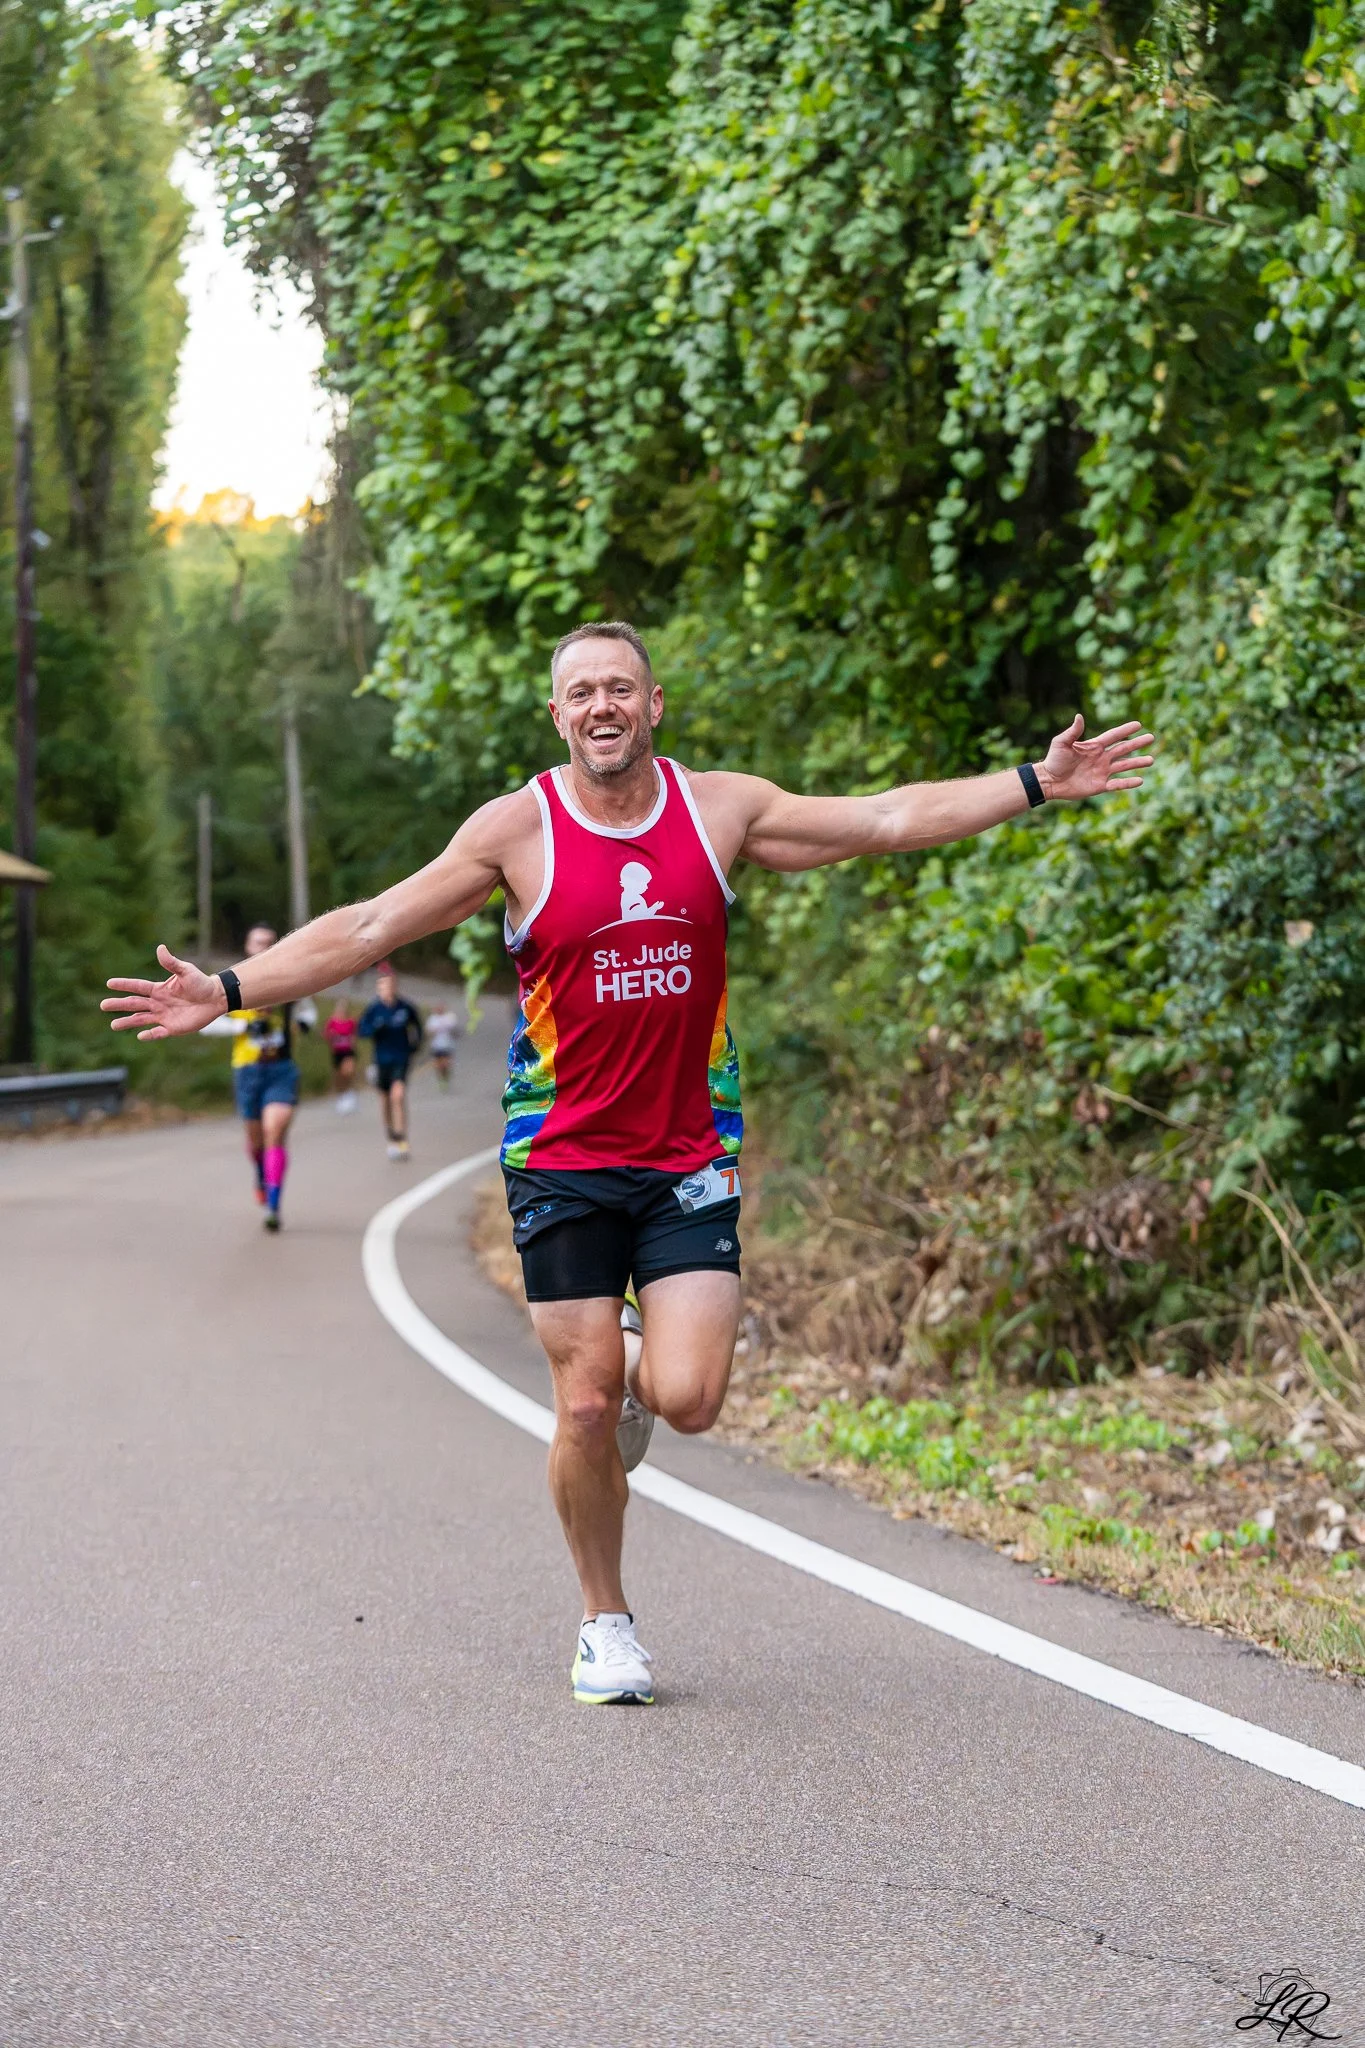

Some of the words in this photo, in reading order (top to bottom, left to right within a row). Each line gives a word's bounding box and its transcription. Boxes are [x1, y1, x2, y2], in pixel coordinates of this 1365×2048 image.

[593, 949, 628, 970] St.
[633, 940, 692, 966] Jude
[595, 965, 692, 1003] HERO
[720, 1168, 740, 1195] 7
